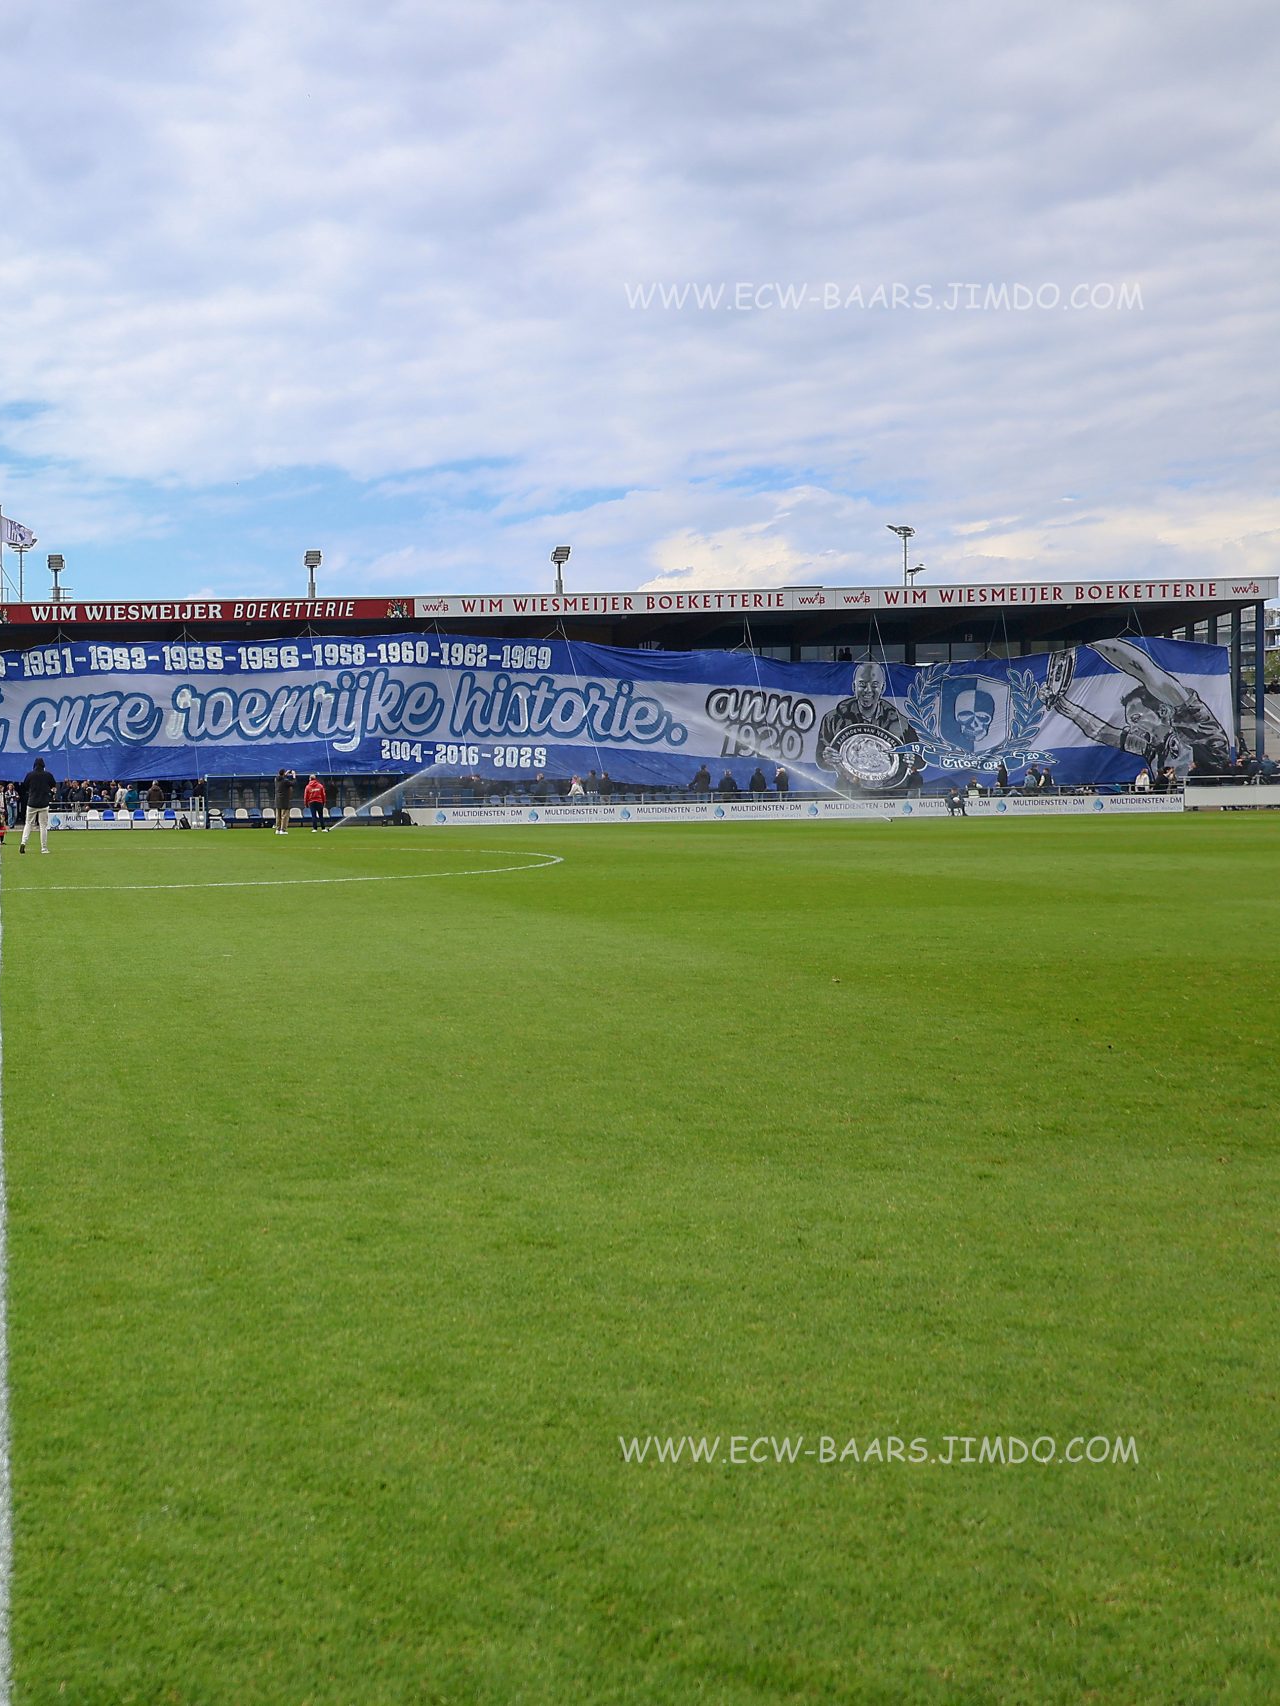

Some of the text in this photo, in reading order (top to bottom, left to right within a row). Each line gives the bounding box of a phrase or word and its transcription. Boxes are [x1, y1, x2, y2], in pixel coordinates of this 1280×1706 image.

[461, 593, 785, 613] WIM WIESMEIJER BOEKETTERIE
[884, 583, 1217, 605] WIM WIESMEIJER BOEKETTERIE
[30, 601, 355, 621] WIM WIESMEIJER BOEKETTERIE
[19, 691, 163, 753] onze
[172, 668, 444, 752] roemrijke
[449, 671, 689, 746] historie.
[705, 688, 817, 734] anno
[720, 720, 804, 761] 1920
[1026, 752, 1039, 760] 20
